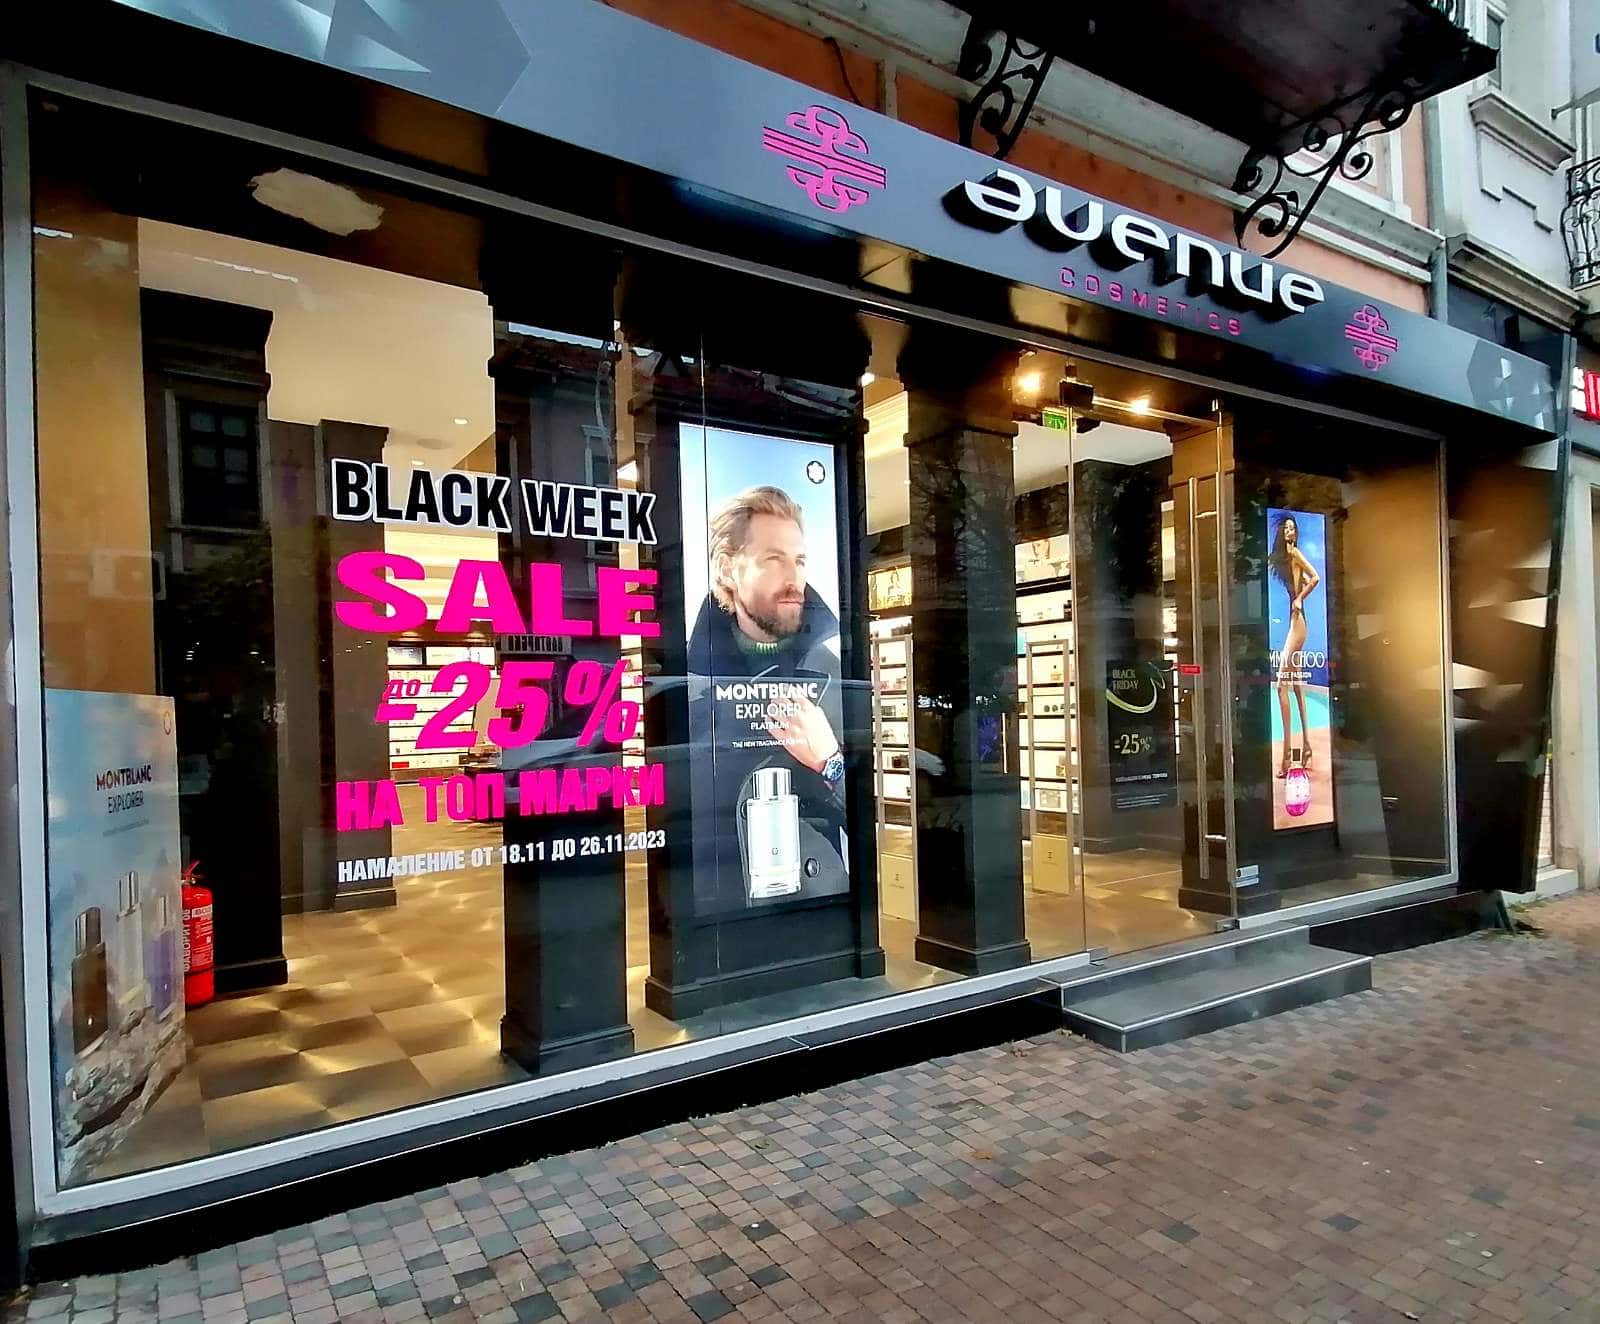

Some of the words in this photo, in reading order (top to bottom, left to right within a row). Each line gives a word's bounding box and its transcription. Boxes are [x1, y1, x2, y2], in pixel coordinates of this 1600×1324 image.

[1058, 266, 1242, 337] COSMETICS
[331, 458, 512, 533] BLACK
[520, 479, 657, 545] WEEK
[335, 551, 661, 637] SALE
[1291, 650, 1326, 668] CHOO
[716, 682, 818, 701] MONTBLANC
[735, 702, 801, 720] EXPLORER
[750, 720, 790, 731] PLATINUM
[96, 764, 152, 792] MONTBLANC
[107, 790, 145, 814] EXPLORER
[336, 778, 405, 832] НА
[419, 772, 505, 824] ТОП
[519, 762, 665, 817] МАРКИ
[338, 849, 466, 883] НАМАЛЕНИЕ
[471, 846, 494, 868] ОТ
[500, 840, 545, 865] 18.11
[551, 838, 577, 862] ДО
[580, 829, 666, 857] 26.11.2023
